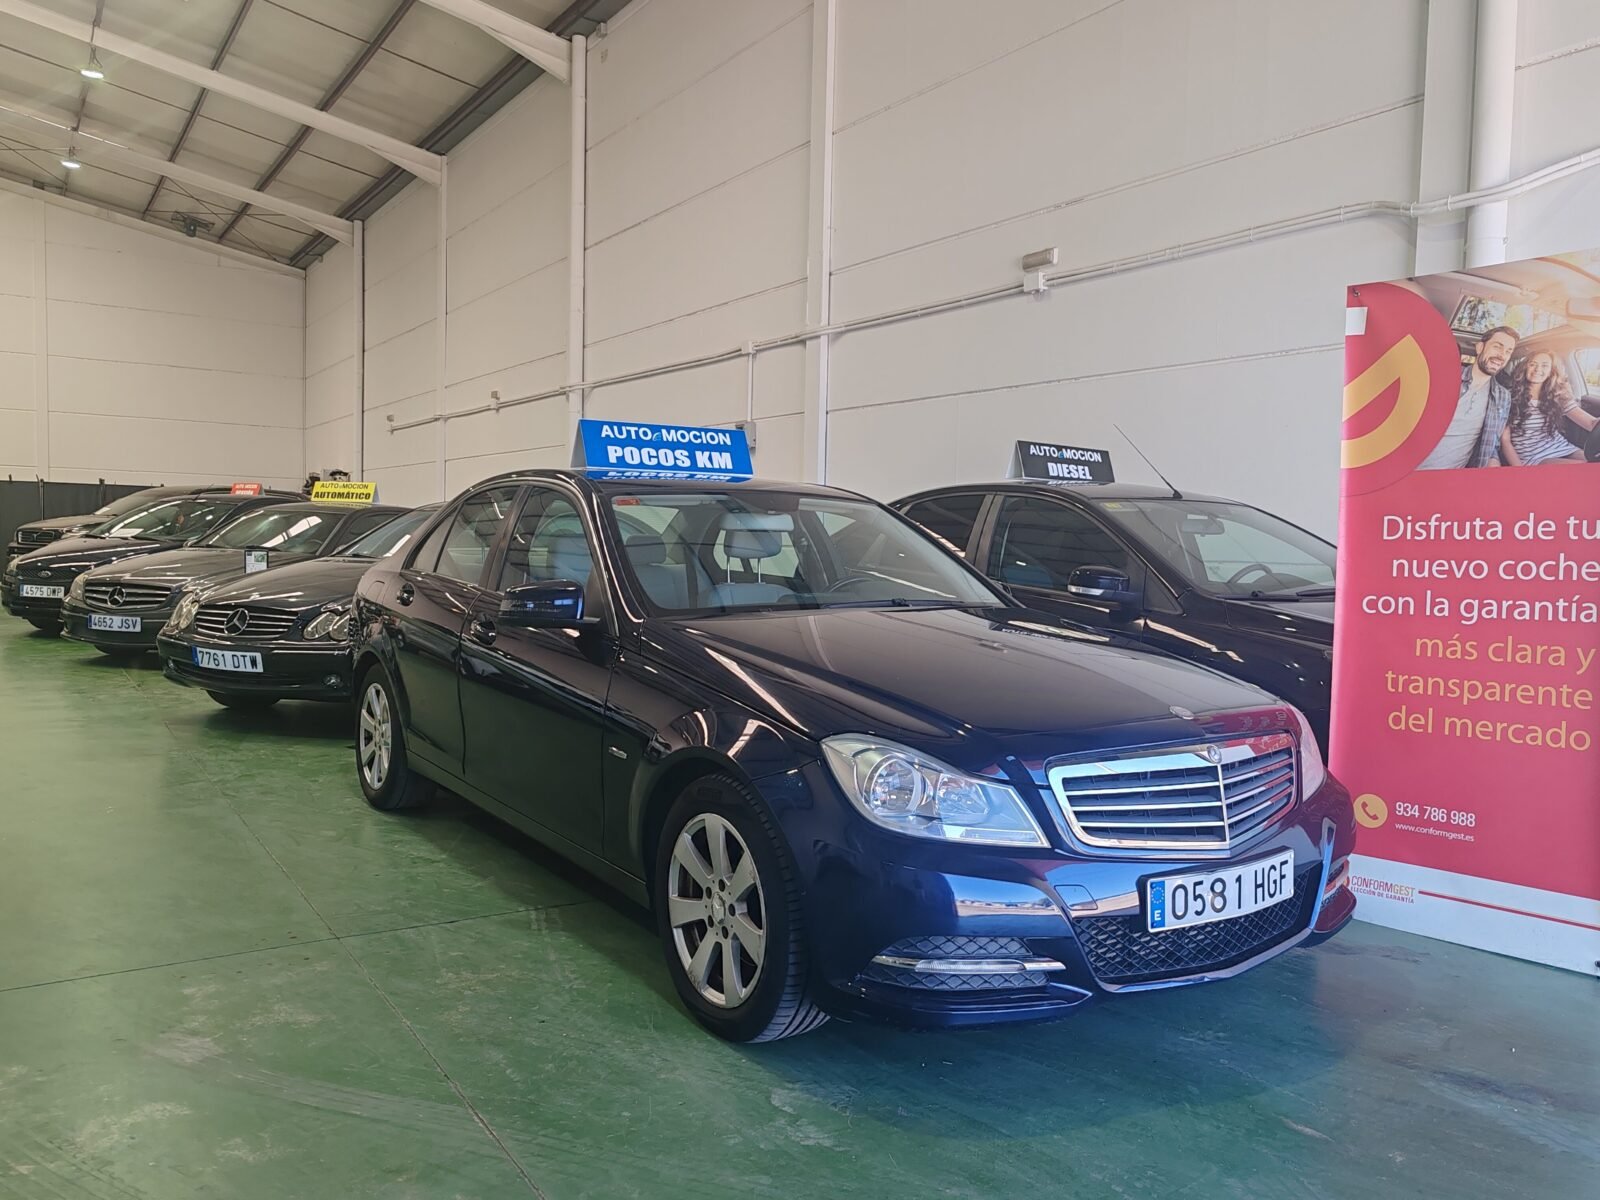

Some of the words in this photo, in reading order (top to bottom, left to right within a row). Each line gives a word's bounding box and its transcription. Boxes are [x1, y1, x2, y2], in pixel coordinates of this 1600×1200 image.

[607, 446, 690, 467] POCOS
[696, 451, 733, 469] KM
[1047, 462, 1092, 480] DIESEL
[313, 490, 371, 500] AUTOMÁTICO
[1383, 513, 1502, 540] Disfruta
[1513, 512, 1556, 540] de
[1567, 515, 1600, 540] tu
[1392, 558, 1489, 579] nuevo
[1498, 553, 1600, 582] coche
[25, 586, 44, 596] 4575
[1362, 594, 1415, 615] con
[1425, 590, 1449, 617] la
[1459, 595, 1598, 625] garantía
[92, 615, 114, 629] 4652
[117, 618, 138, 630] JSV
[199, 650, 227, 668] 7761
[231, 654, 258, 670] DTW
[1415, 633, 1478, 660] más
[1488, 635, 1566, 666] clara
[1576, 647, 1596, 675] y
[1385, 670, 1593, 710] transparente
[1388, 705, 1433, 734] del
[1444, 715, 1591, 751] mercado
[1395, 801, 1420, 818] 934
[1423, 806, 1448, 823] 786
[1450, 810, 1476, 828] 988
[1394, 822, 1475, 842] www.conformgest.es
[1154, 909, 1162, 921] E
[1171, 874, 1242, 921] 0581
[1254, 859, 1289, 905] HGF
[1351, 875, 1416, 897] CONFORMGEST
